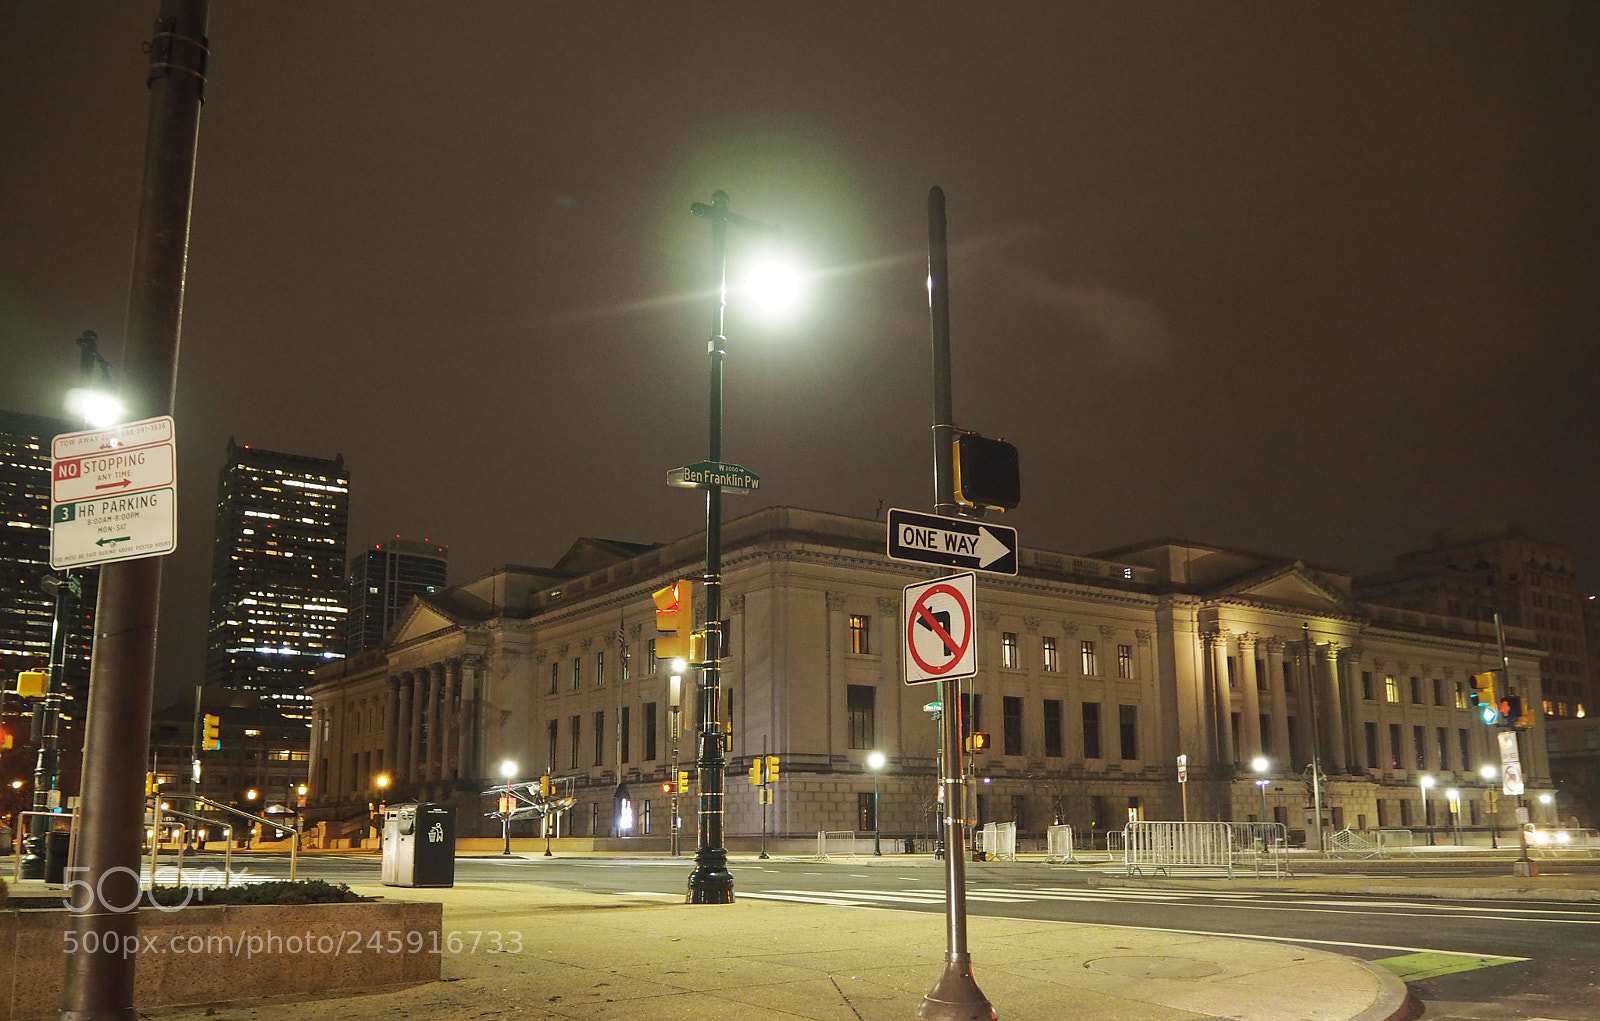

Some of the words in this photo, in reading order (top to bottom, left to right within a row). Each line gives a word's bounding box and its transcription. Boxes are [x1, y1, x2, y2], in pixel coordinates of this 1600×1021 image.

[60, 439, 75, 447] TOW
[78, 435, 98, 444] AWAY
[102, 430, 119, 441] ZON
[58, 463, 77, 478] NO
[83, 452, 146, 474] STOPPING
[97, 473, 111, 481] ANY
[115, 470, 131, 478] TIME
[684, 467, 703, 482] Ben
[704, 470, 744, 487] Franklin
[62, 507, 69, 520] 3
[78, 504, 95, 518] HR
[102, 494, 158, 514] PARKING
[97, 523, 127, 534] MON-SAT
[903, 526, 938, 549] ONE
[944, 533, 979, 554] WAY
